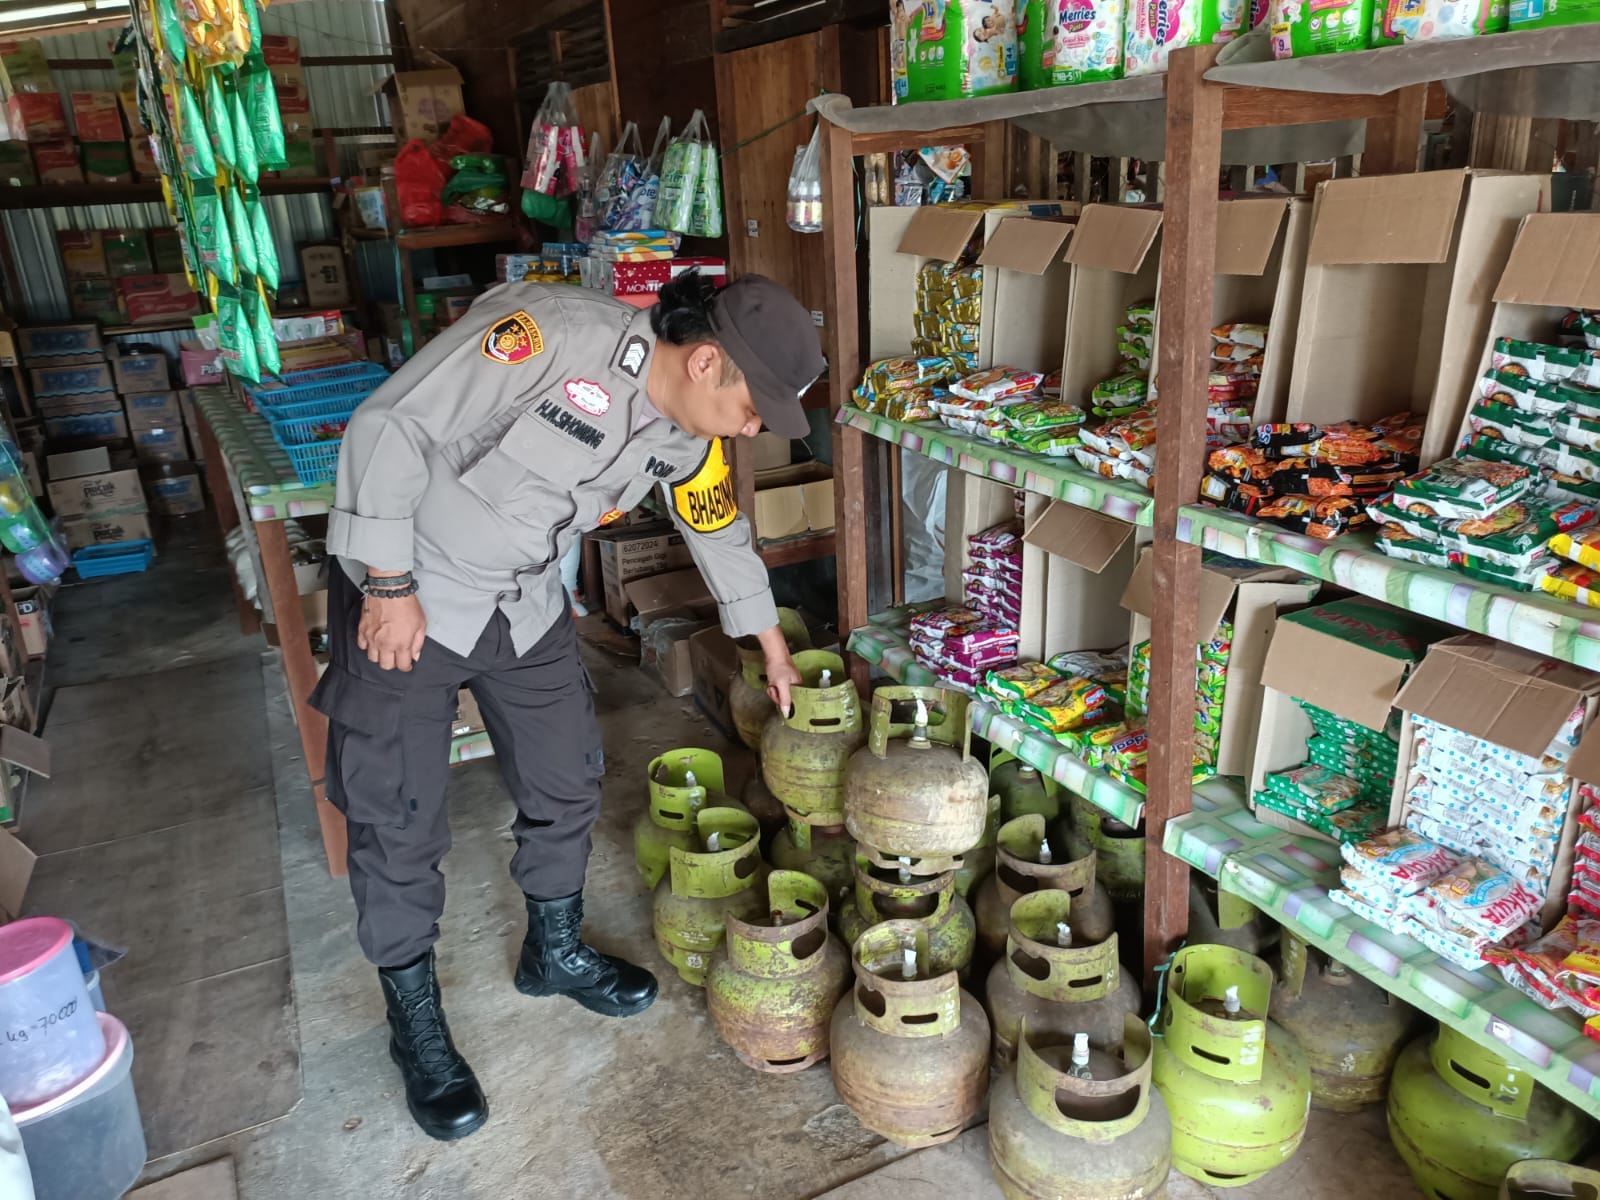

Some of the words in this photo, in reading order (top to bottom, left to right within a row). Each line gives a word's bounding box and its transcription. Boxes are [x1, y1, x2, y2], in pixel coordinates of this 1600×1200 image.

[1059, 7, 1097, 25] Merries
[1155, 1, 1169, 47] erries
[1391, 848, 1460, 880] SAKURA
[1481, 881, 1538, 925] SAKURA
